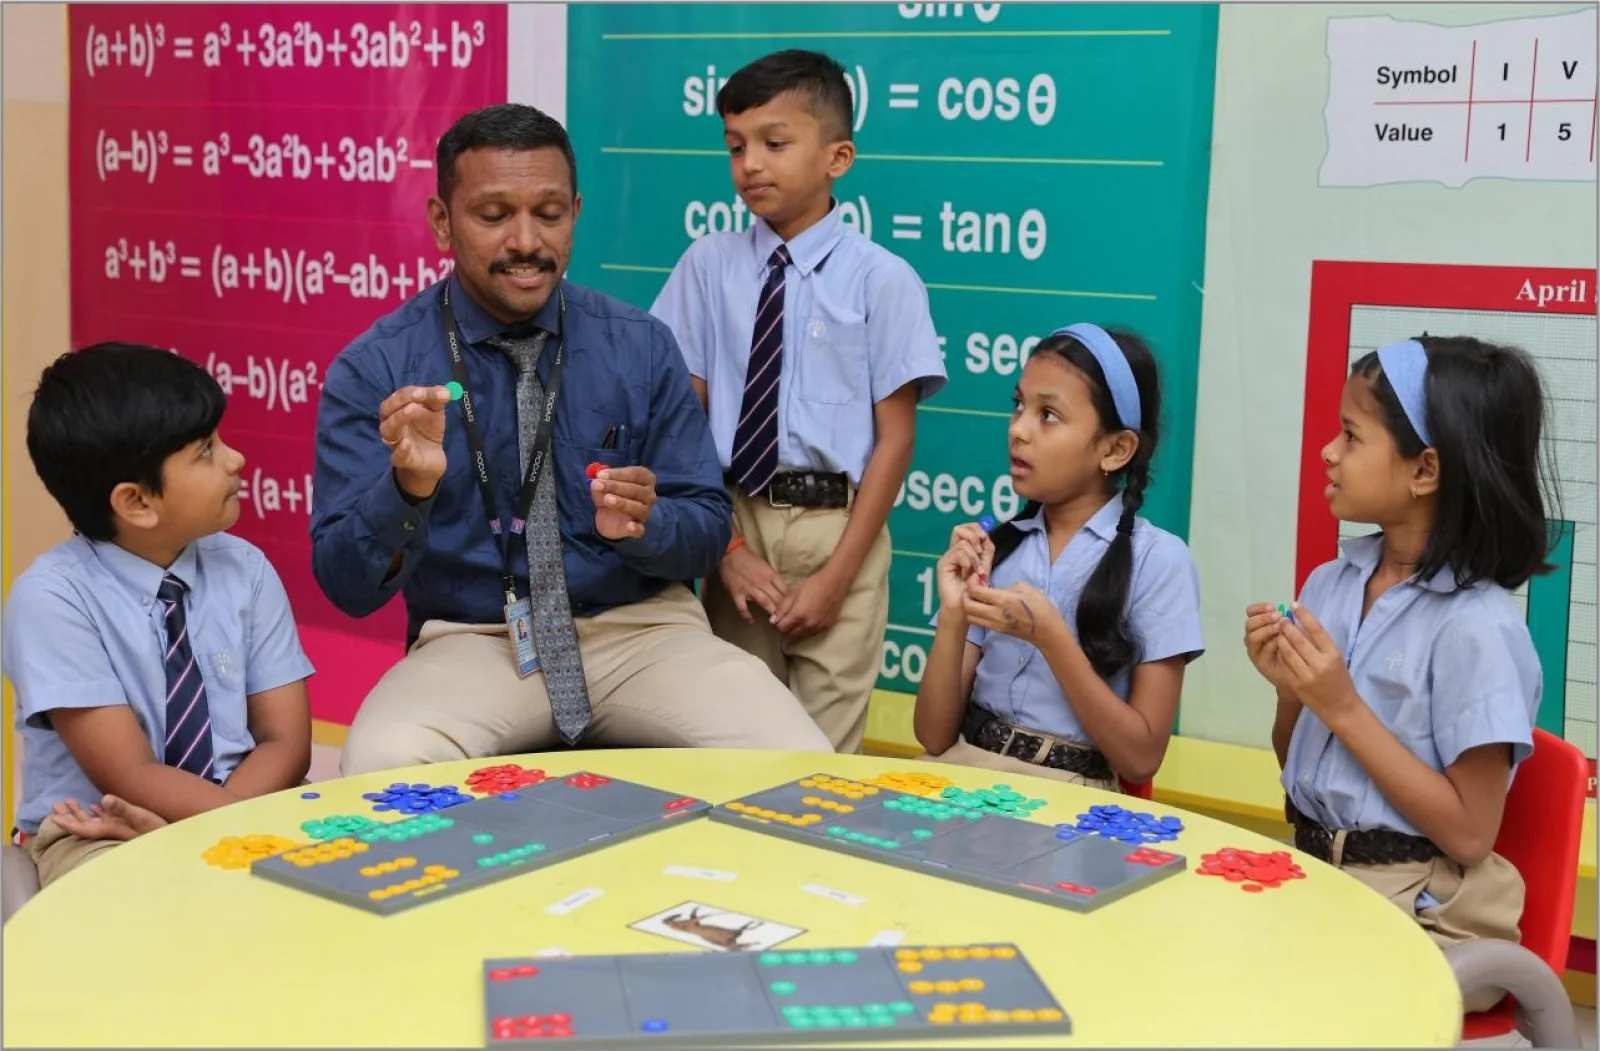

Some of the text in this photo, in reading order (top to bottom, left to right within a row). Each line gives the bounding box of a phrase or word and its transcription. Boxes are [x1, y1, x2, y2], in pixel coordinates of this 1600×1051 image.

[1377, 65, 1457, 89] Symbol
[1562, 61, 1579, 80] V
[682, 65, 728, 117] si
[1375, 123, 1572, 142] Value 1 5
[1515, 277, 1586, 308] April
